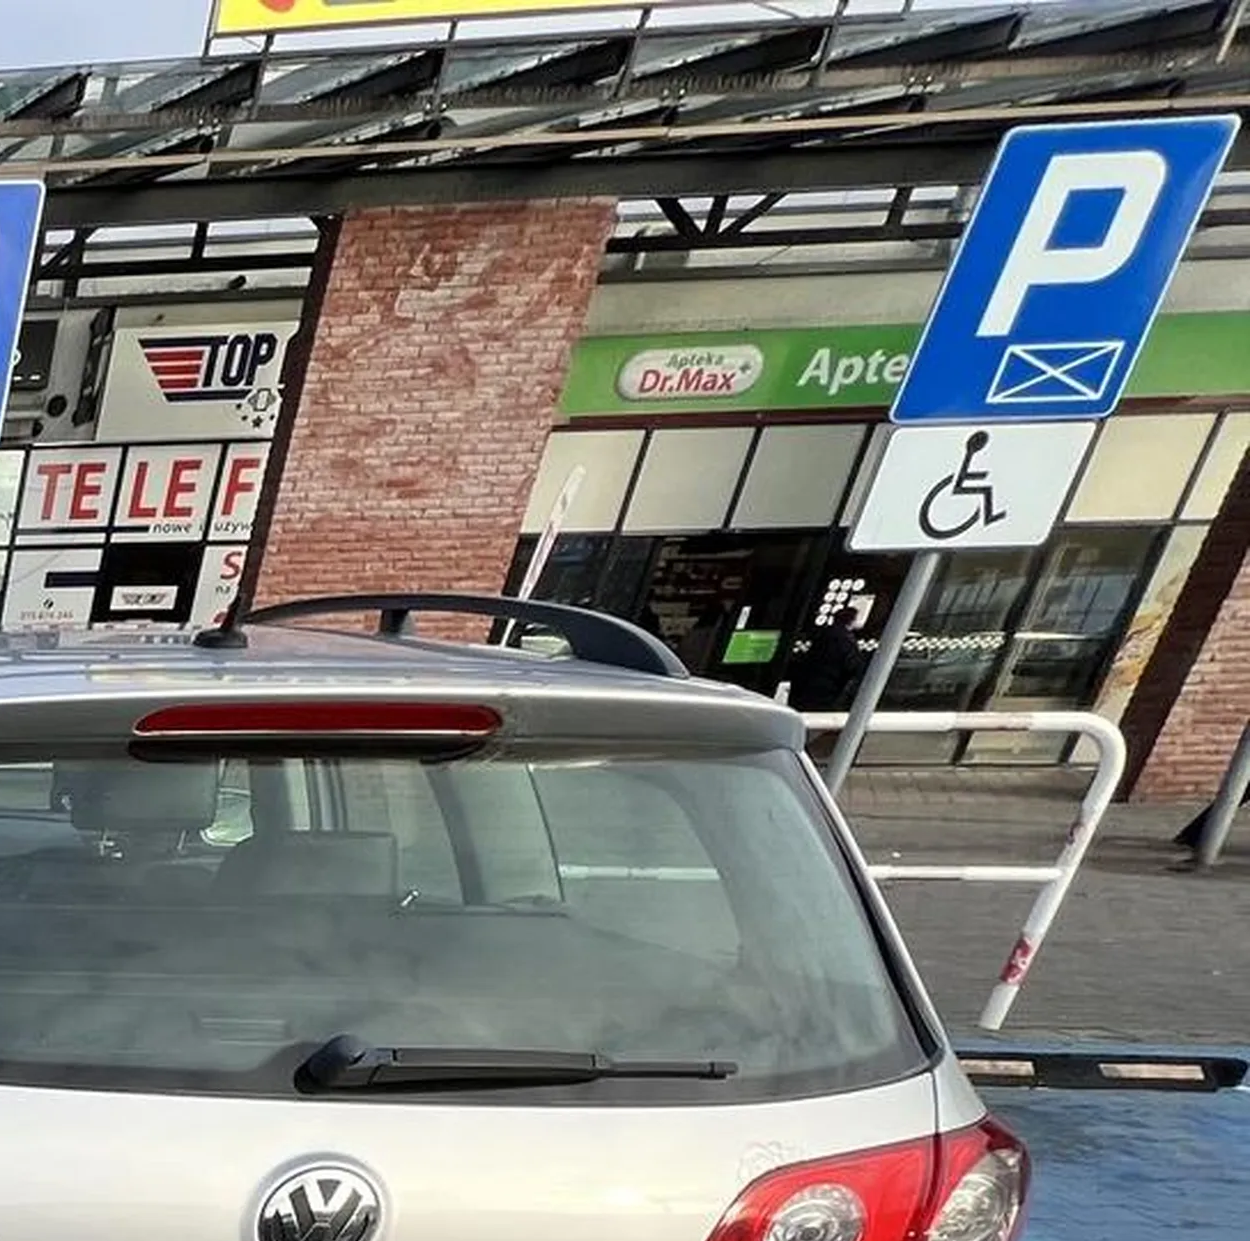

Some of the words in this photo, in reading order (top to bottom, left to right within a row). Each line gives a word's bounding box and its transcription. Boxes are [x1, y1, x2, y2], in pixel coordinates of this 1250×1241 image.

[975, 149, 1166, 336] P
[202, 334, 276, 386] TOP
[665, 352, 724, 367] Apteka
[638, 369, 735, 393] Dr.Max
[153, 523, 192, 534] nowe
